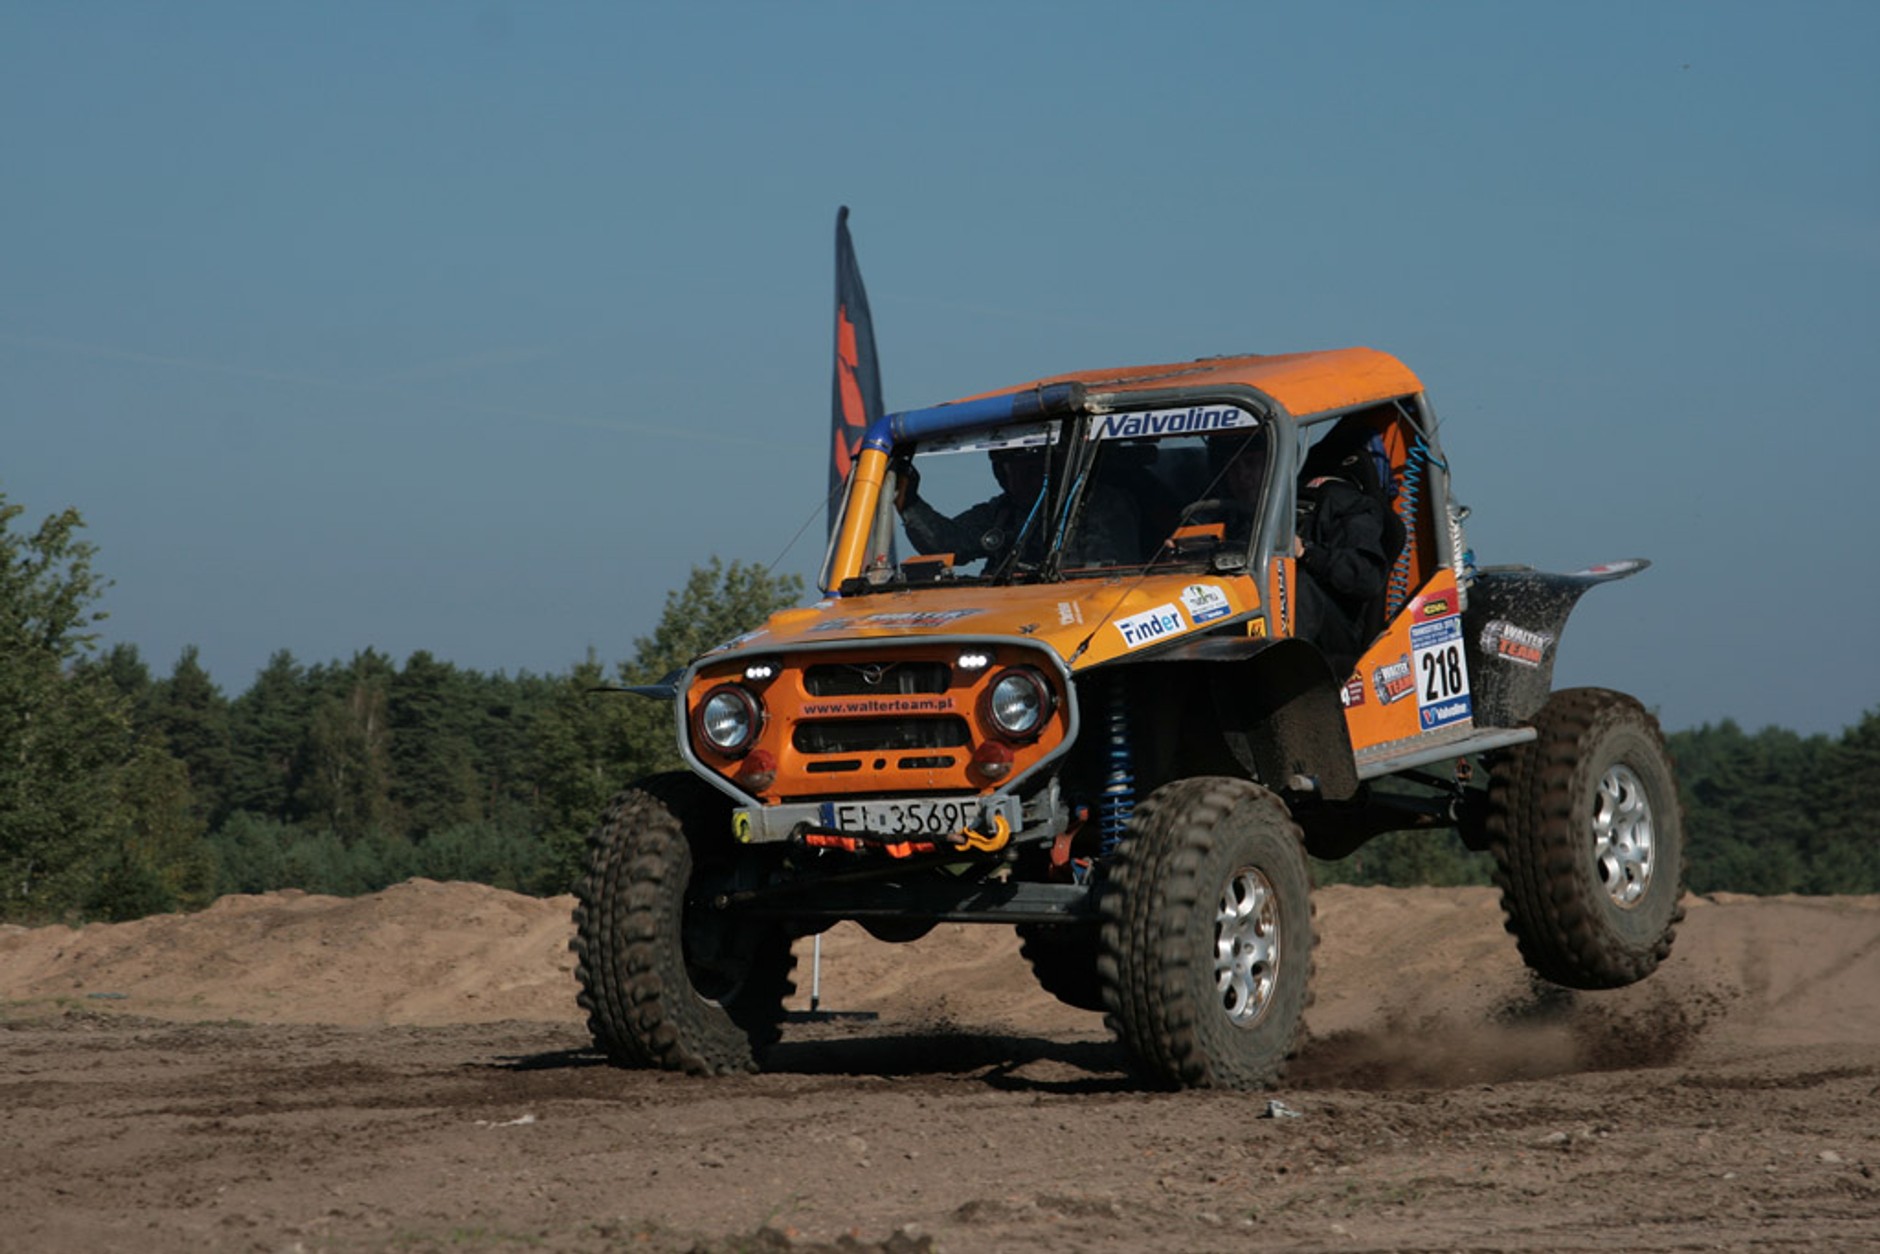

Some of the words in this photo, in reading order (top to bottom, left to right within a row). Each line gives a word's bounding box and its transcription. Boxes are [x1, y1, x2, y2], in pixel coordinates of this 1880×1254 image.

[1105, 407, 1240, 437] Valvoline
[1120, 612, 1180, 645] Finder
[1498, 637, 1542, 663] TEAM
[1422, 646, 1462, 701] 218
[803, 698, 954, 715] www.walterteam.pl
